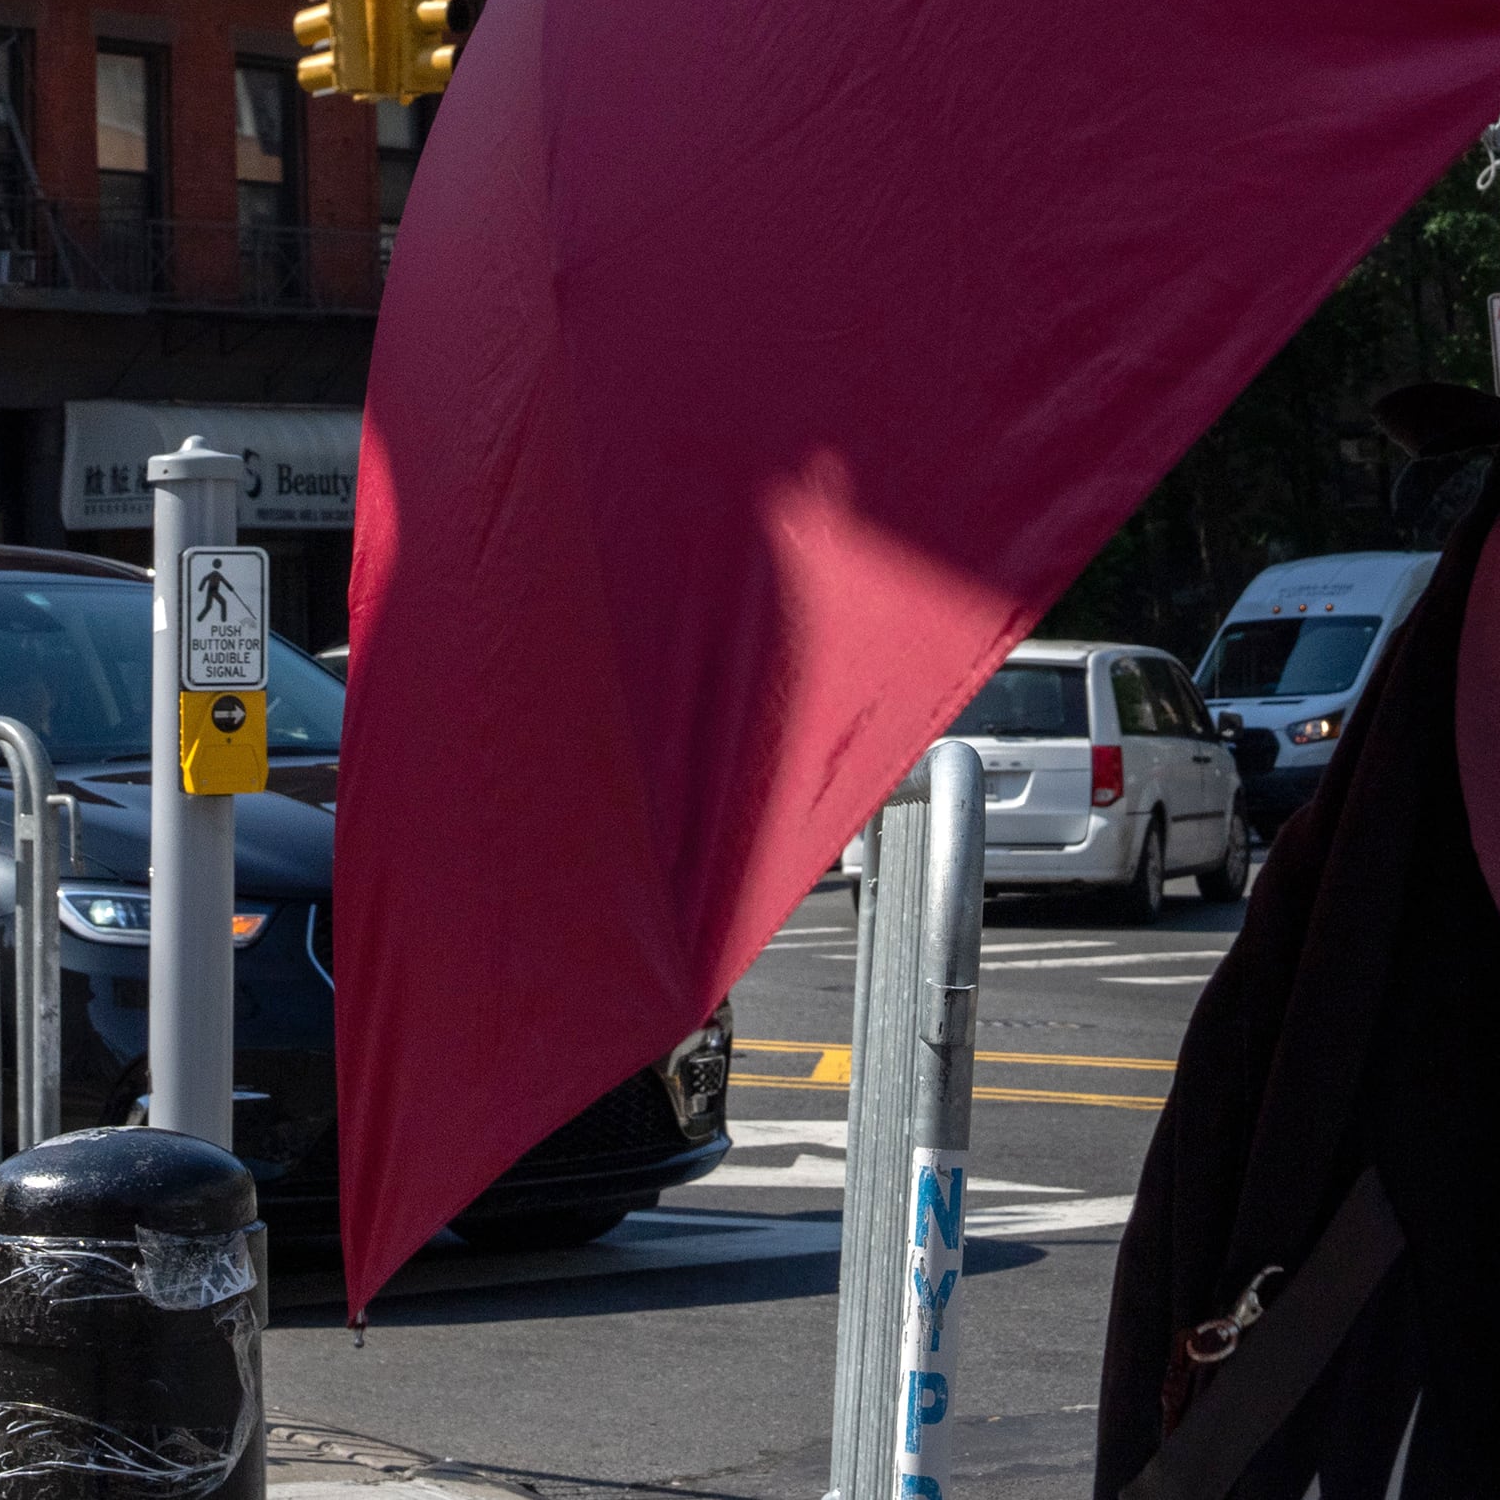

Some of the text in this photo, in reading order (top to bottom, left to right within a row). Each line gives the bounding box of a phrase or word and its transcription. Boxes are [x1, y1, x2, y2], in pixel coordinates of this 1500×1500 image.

[278, 463, 354, 503] Beauty
[211, 625, 242, 637] PUSH
[192, 639, 260, 651] BUTTON FOR
[202, 652, 251, 664] AUDIBLE
[206, 666, 247, 678] SIGNAL
